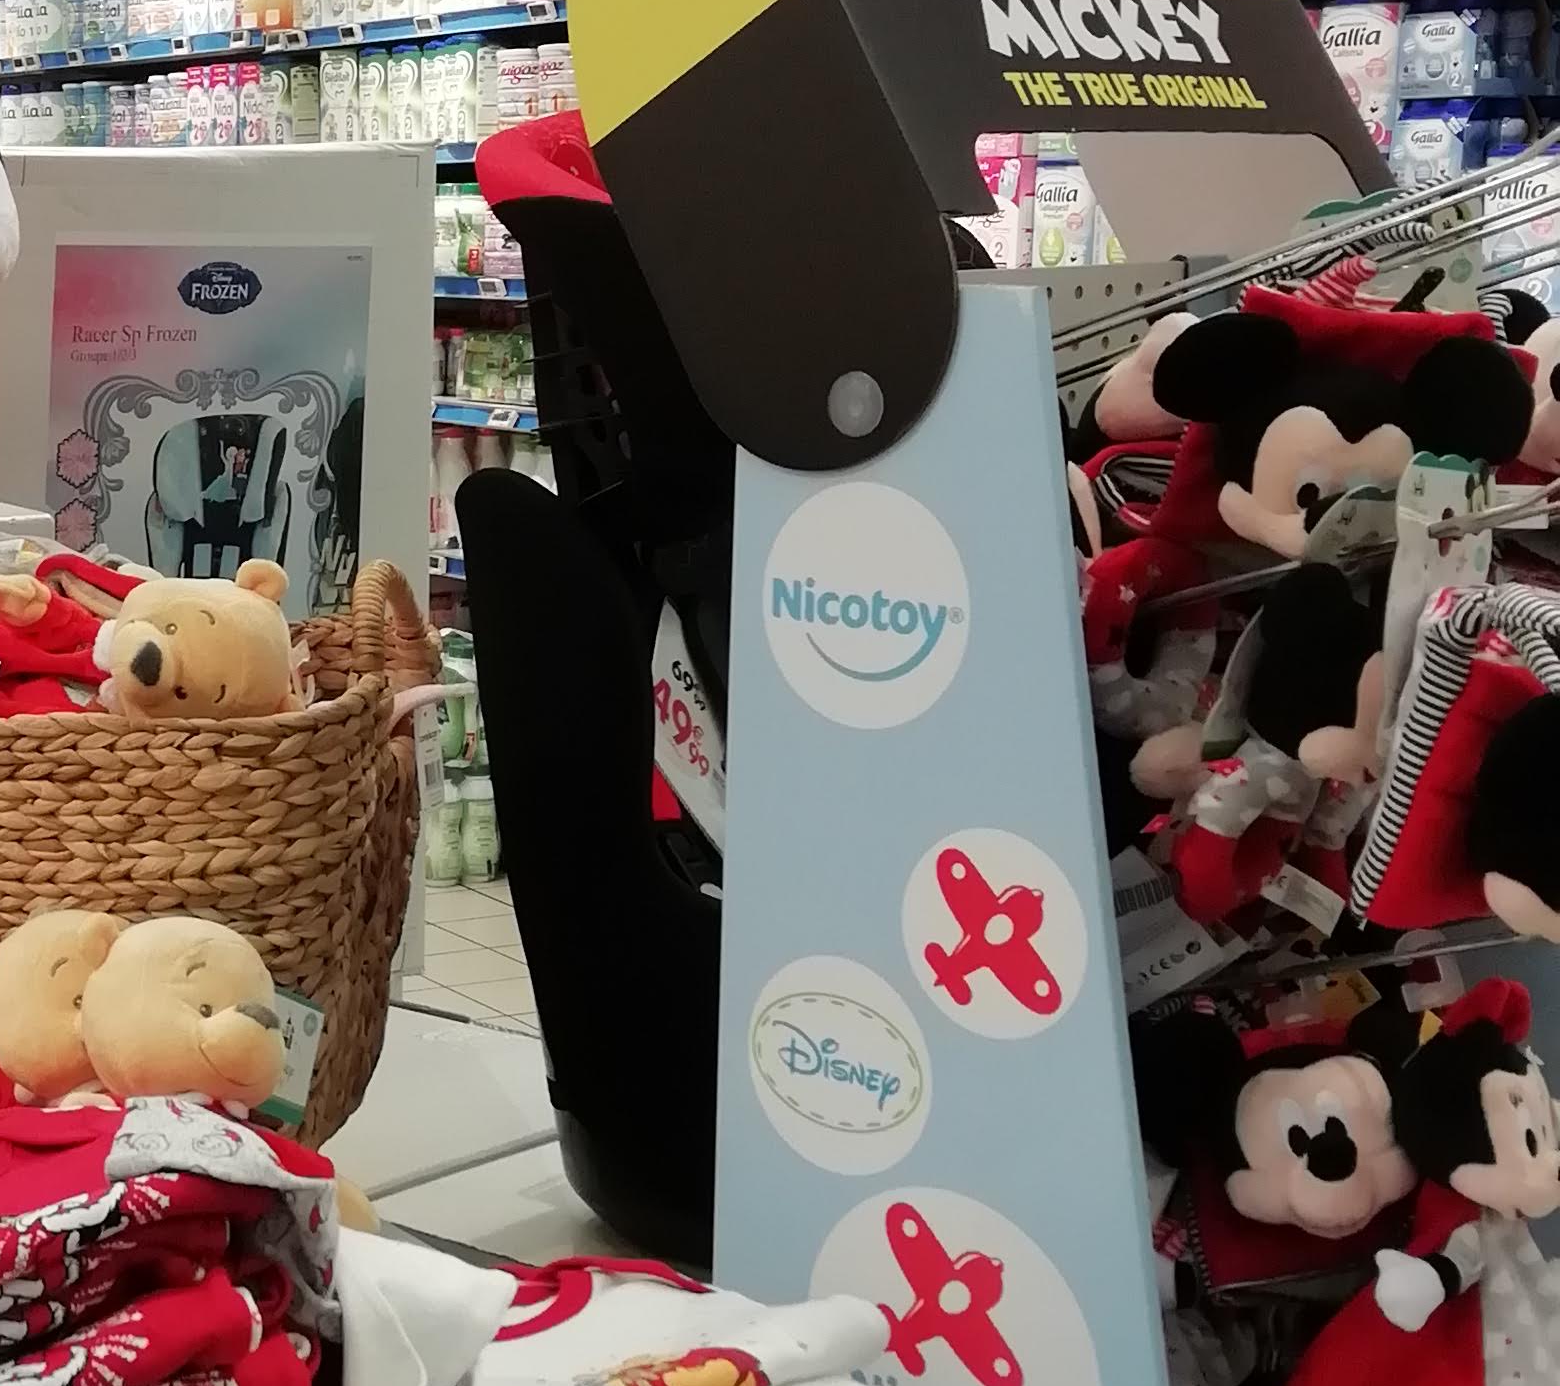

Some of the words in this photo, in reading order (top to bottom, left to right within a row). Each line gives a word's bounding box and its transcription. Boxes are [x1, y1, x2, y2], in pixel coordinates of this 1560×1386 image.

[1323, 24, 1381, 49] Gallia
[1421, 24, 1456, 38] Gallia
[1003, 71, 1072, 107] THE
[1065, 72, 1147, 107] TRUE
[1143, 75, 1268, 110] ORIGINAL
[1411, 131, 1443, 145] Gallia
[1036, 183, 1078, 203] Gallia
[191, 282, 249, 302] FROZEN
[72, 325, 117, 342] Racer
[146, 324, 197, 342] Frozen
[773, 1020, 901, 1111] Disney
